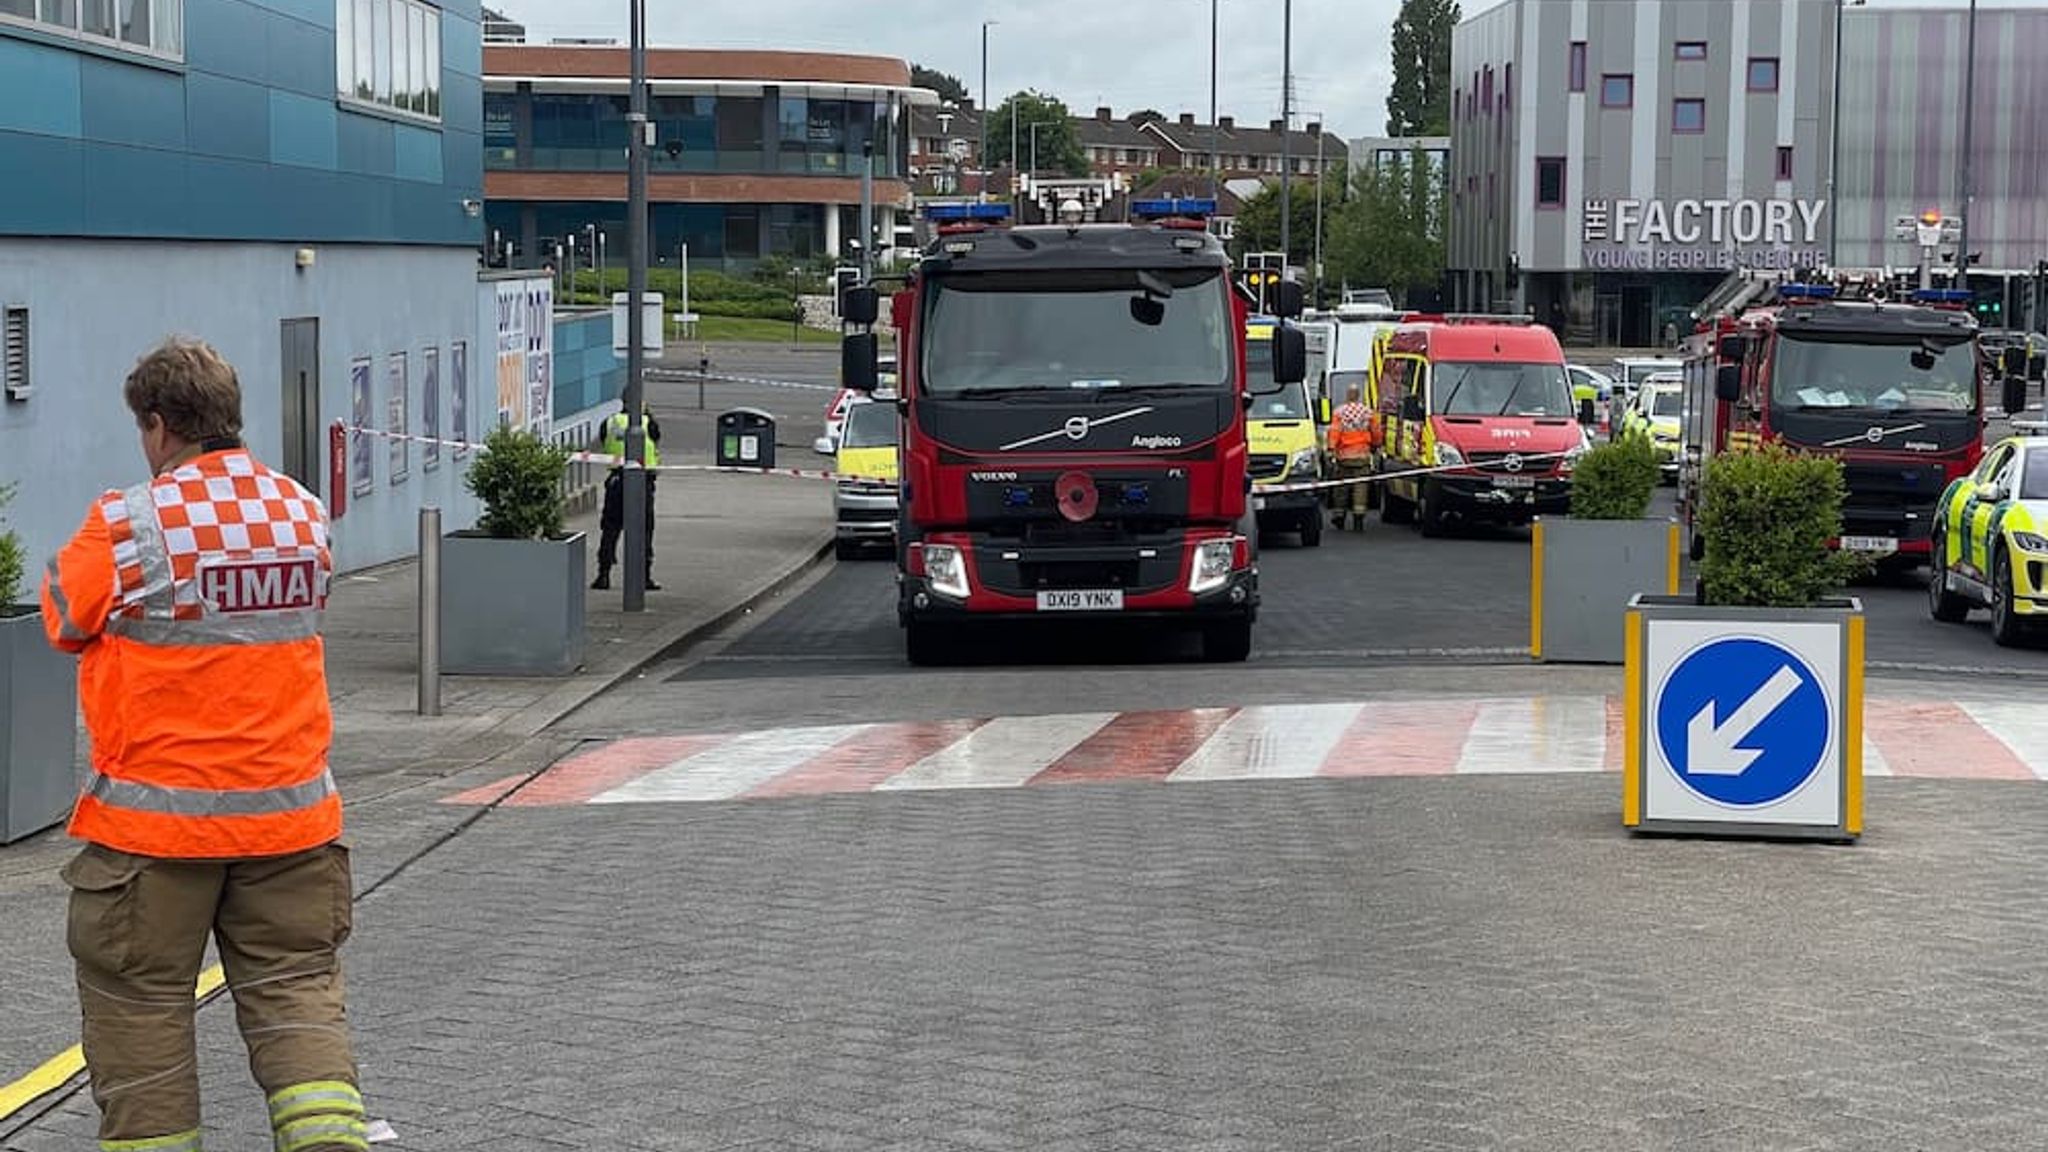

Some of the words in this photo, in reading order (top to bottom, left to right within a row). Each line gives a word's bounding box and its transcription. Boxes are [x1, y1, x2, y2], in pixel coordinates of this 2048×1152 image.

[1585, 200, 1607, 242] THE
[1614, 200, 1826, 243] FACTORY
[1585, 250, 1647, 269] YOUNG
[1132, 434, 1182, 448] Angloco
[971, 471, 1017, 481] VOLVO
[206, 565, 311, 608] HMA
[1047, 592, 1080, 607] DX19
[1085, 591, 1115, 607] YNK
